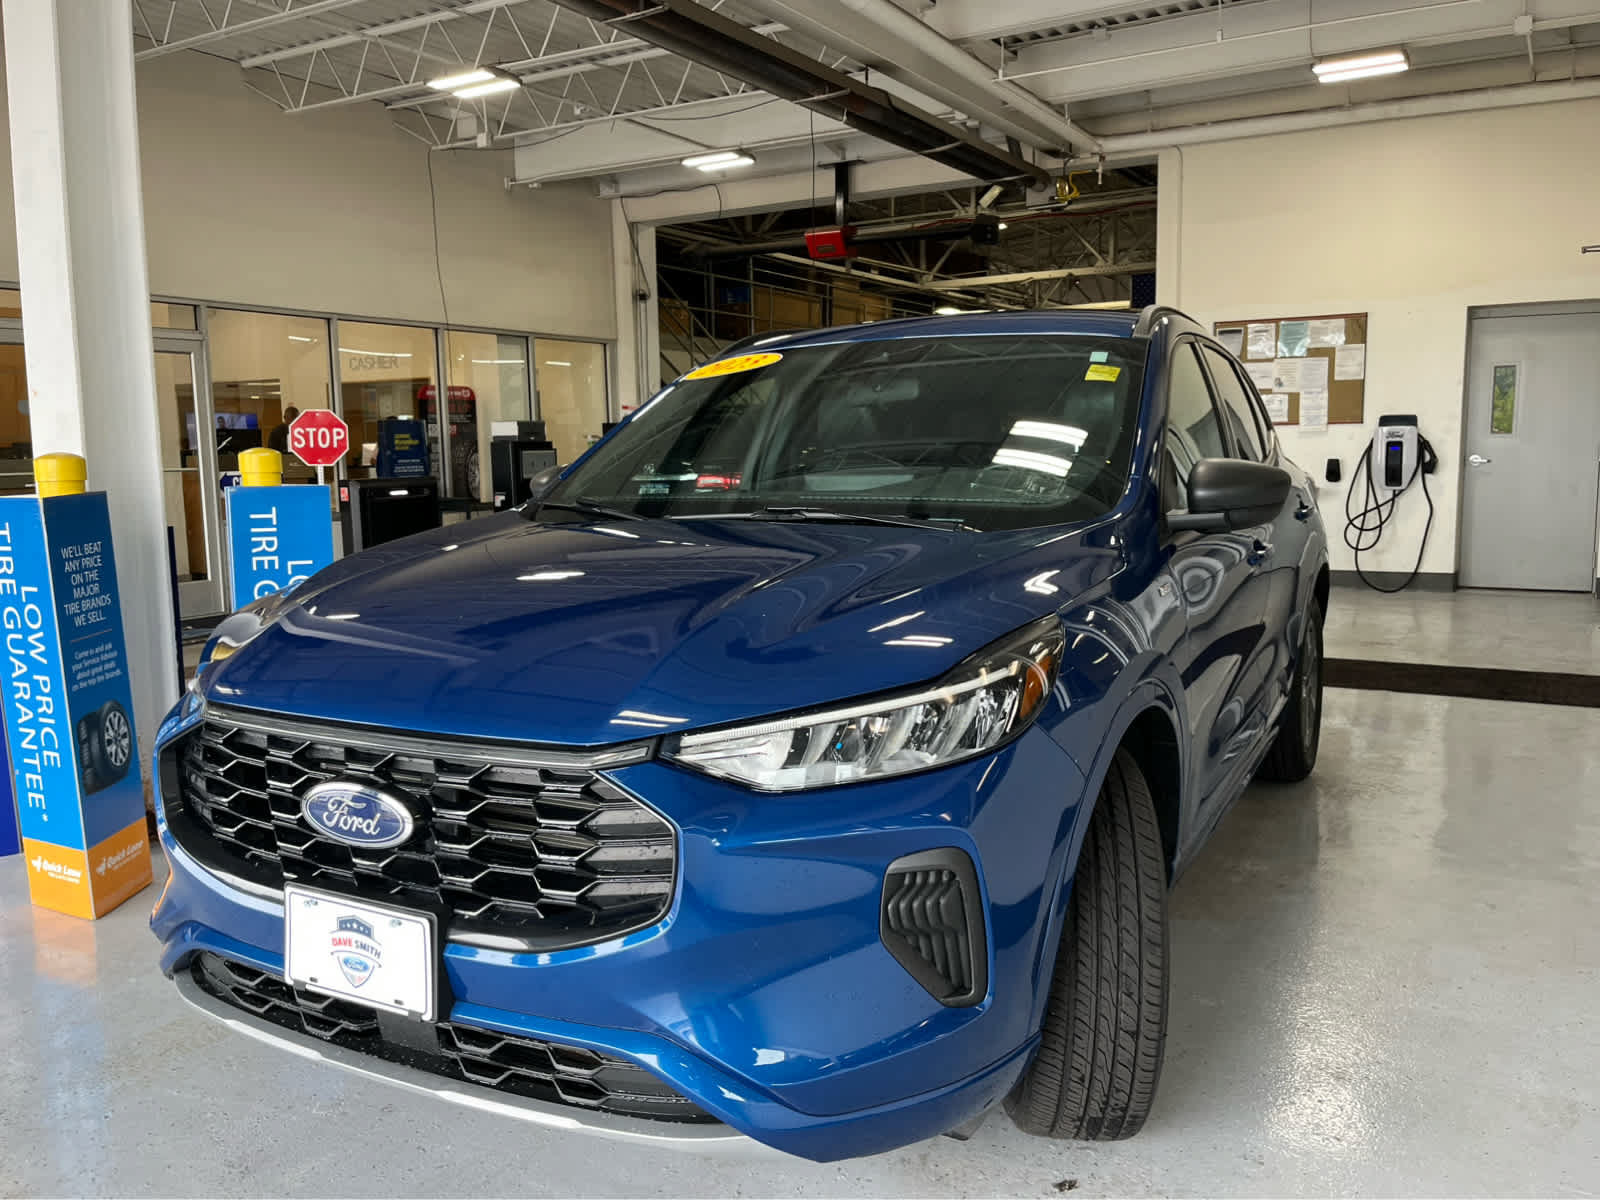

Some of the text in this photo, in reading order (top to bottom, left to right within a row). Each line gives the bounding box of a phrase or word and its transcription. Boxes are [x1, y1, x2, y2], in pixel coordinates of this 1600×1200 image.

[349, 356, 399, 370] CASHIER
[293, 427, 345, 449] STOP
[250, 506, 280, 571] TIRE
[0, 522, 17, 596] TIRE
[61, 541, 103, 560] WE'LL BEAT
[64, 555, 103, 574] ANY PRICE
[71, 569, 100, 586] ON THE
[73, 583, 101, 599] MAJOR
[64, 593, 112, 616] TIRE BRANDS
[74, 614, 88, 628] WE
[20, 585, 62, 769] LOW PRICE
[322, 795, 381, 836] Ford
[332, 936, 381, 960] DAVE SMITH
